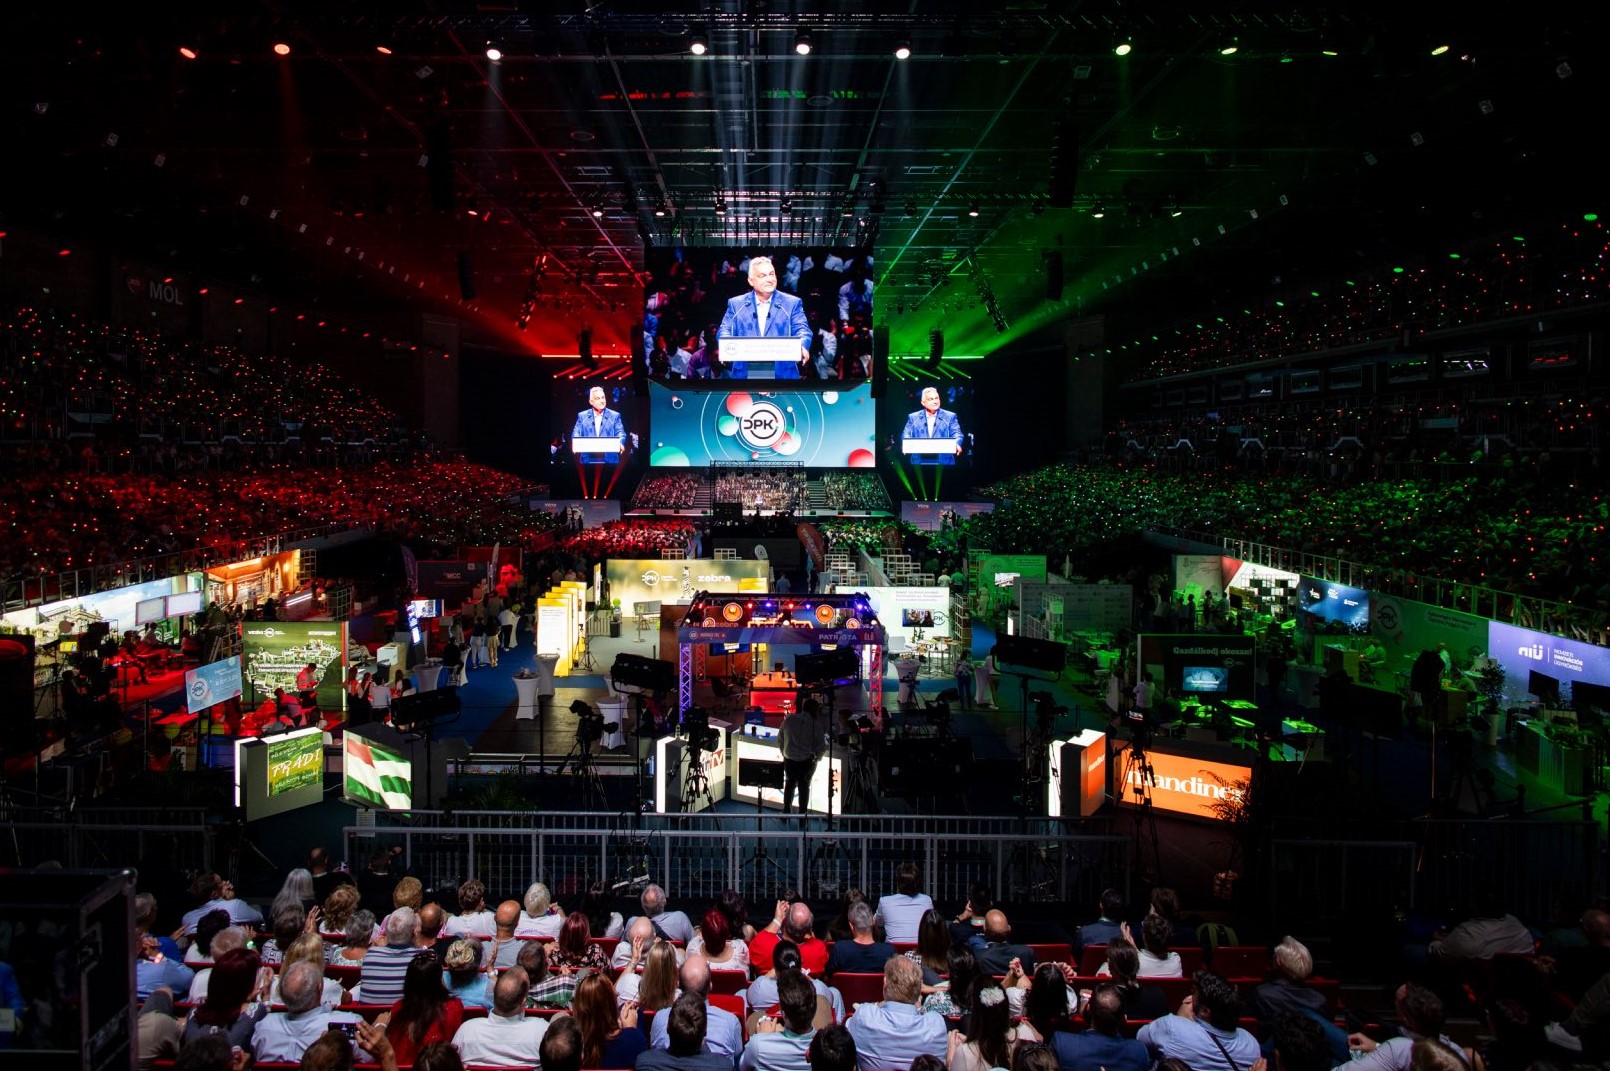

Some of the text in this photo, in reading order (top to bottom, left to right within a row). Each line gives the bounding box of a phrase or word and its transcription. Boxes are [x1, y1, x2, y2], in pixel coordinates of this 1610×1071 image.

[149, 280, 184, 305] MOL
[743, 419, 774, 430] DPK
[697, 574, 731, 582] zebra
[271, 747, 321, 778] FRADI
